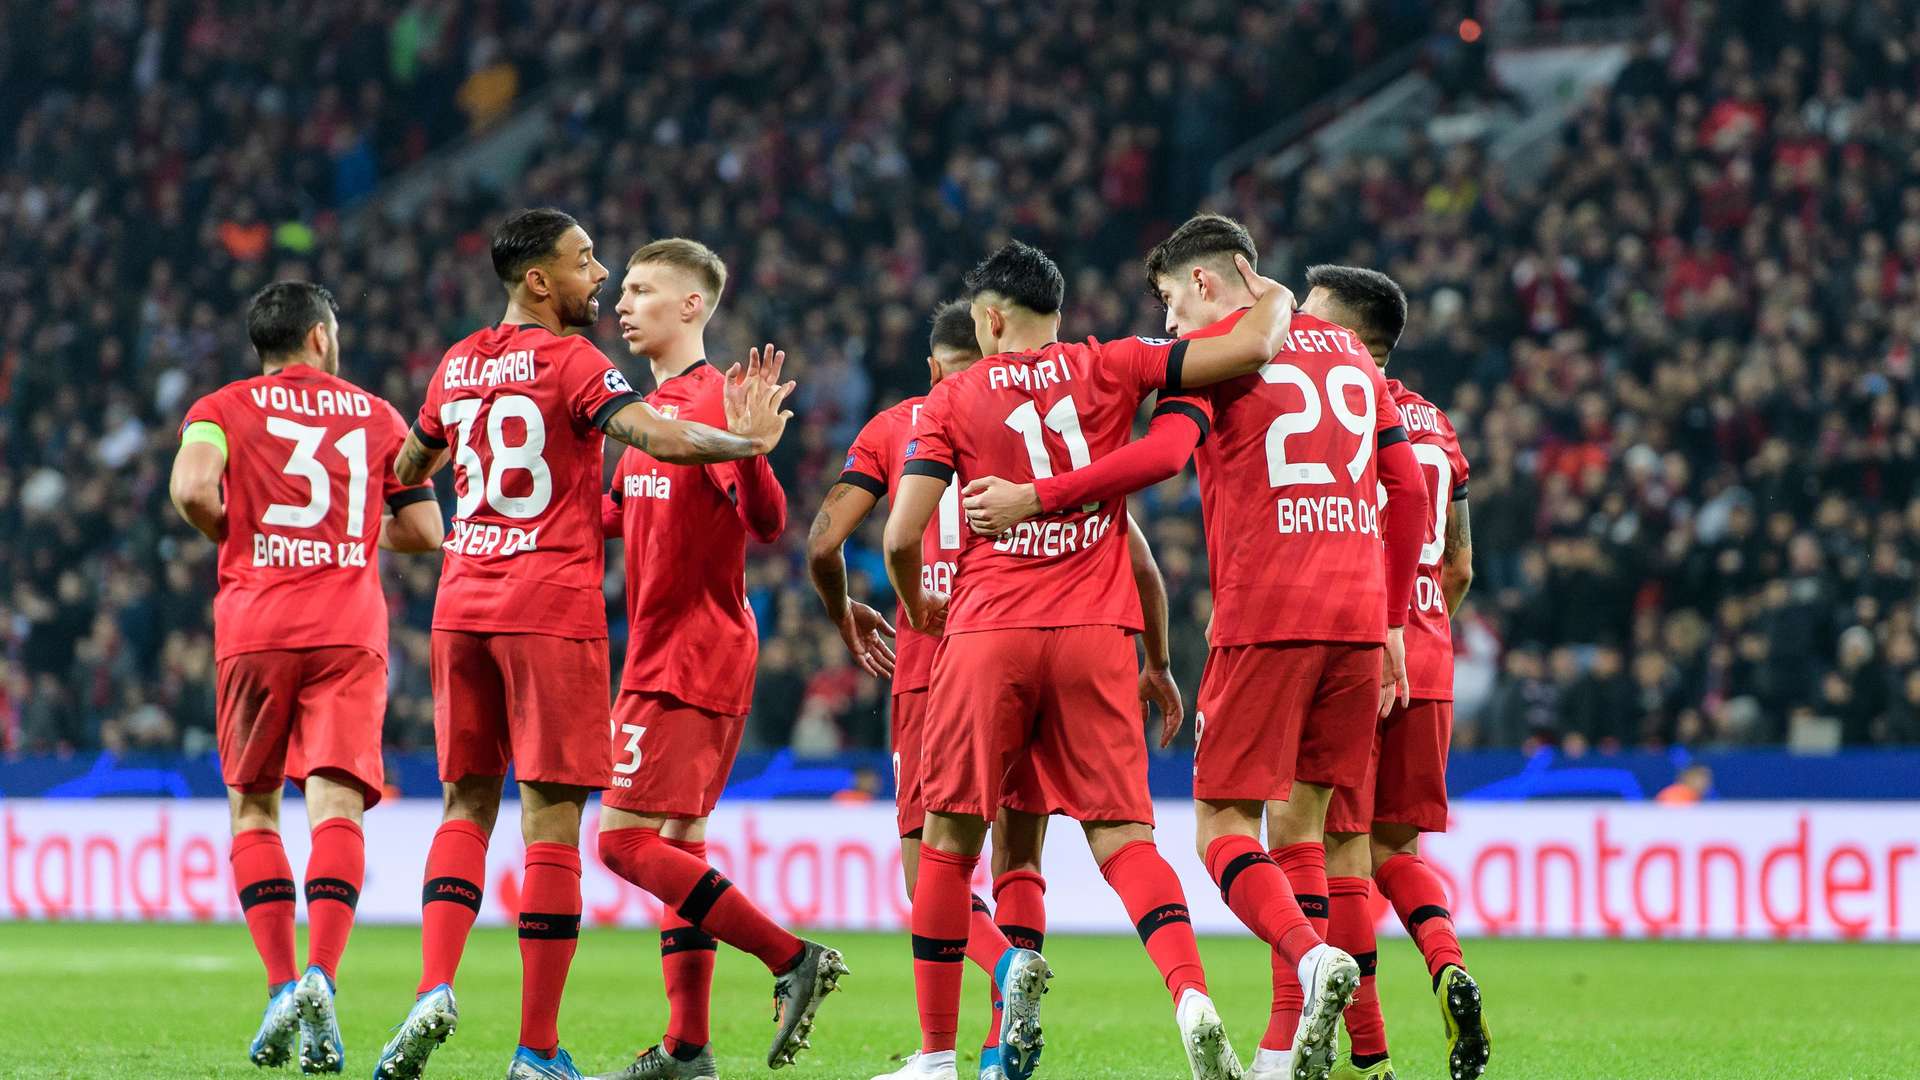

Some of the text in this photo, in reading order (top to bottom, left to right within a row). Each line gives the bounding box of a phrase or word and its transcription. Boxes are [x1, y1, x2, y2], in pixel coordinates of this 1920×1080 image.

[1281, 329, 1360, 356] VERTZ
[444, 350, 535, 390] BELLARABI
[988, 354, 1071, 391] AMIRI
[250, 386, 371, 417] VOLLAND
[1258, 363, 1377, 488] 29
[440, 394, 552, 519] 38
[1004, 394, 1099, 512] 11
[261, 416, 368, 537] 31
[1278, 496, 1379, 538] BAYER 04
[253, 533, 367, 568] BAYER 04
[499, 526, 540, 555] 04
[1416, 576, 1443, 613] 04
[610, 719, 647, 774] 3
[2, 806, 240, 922] tande
[255, 885, 295, 897] JAKO
[308, 884, 349, 896] JAKO
[436, 884, 477, 901] JAKO
